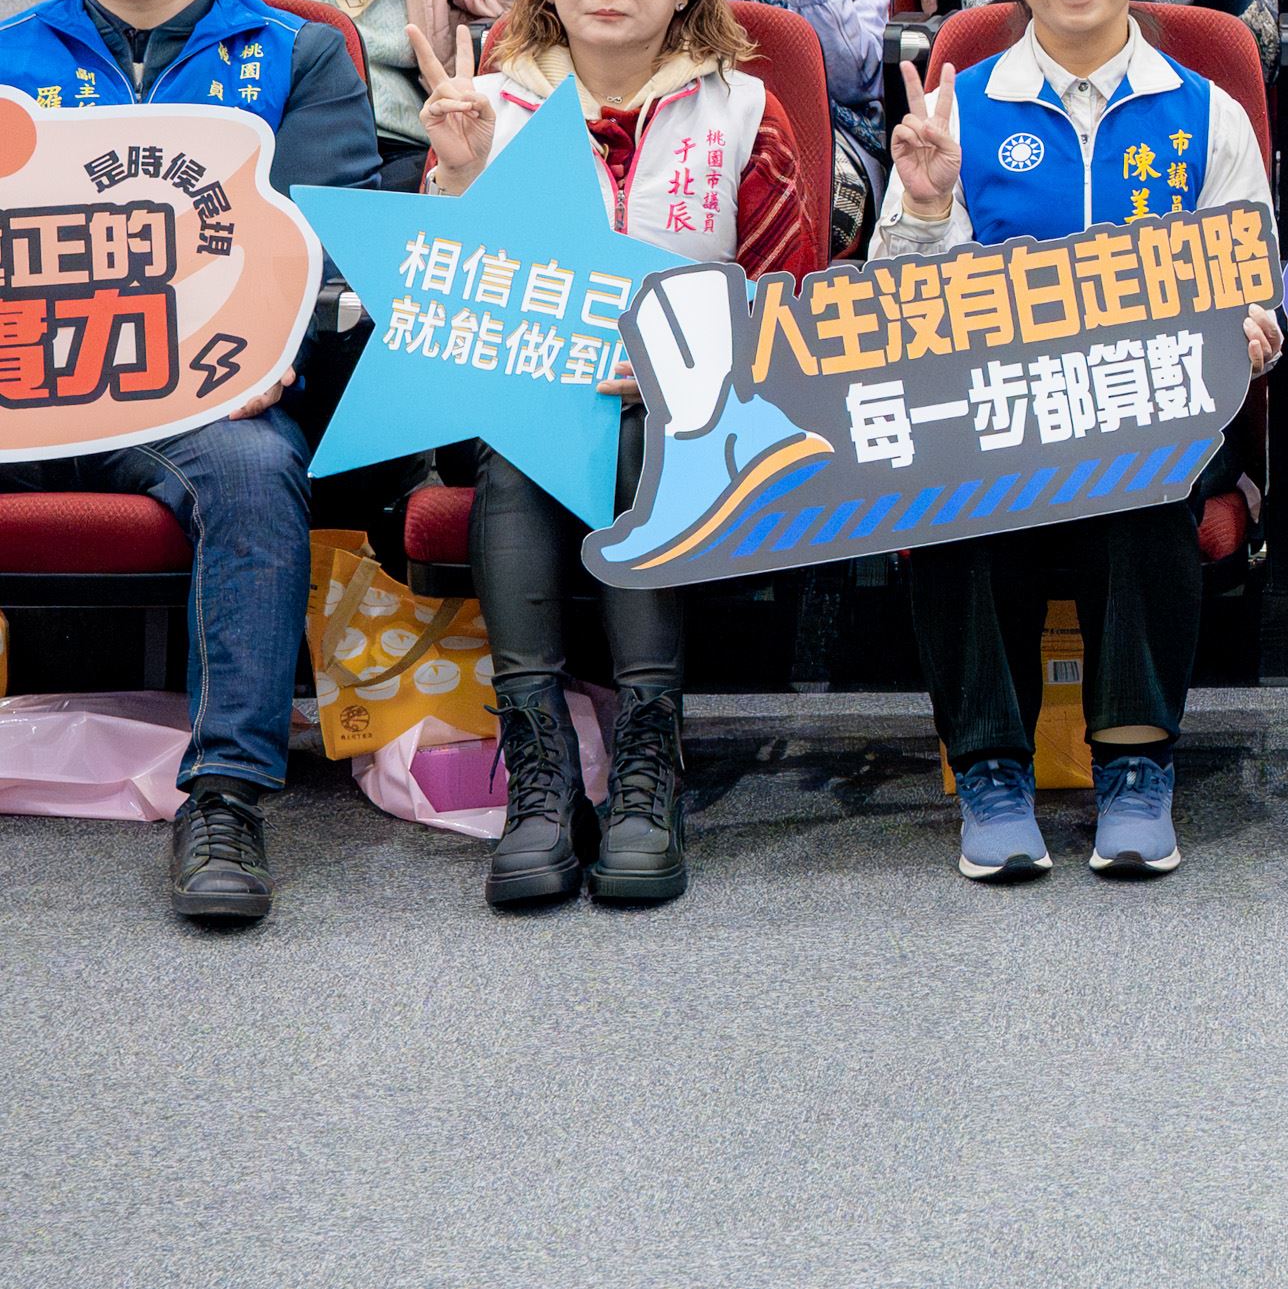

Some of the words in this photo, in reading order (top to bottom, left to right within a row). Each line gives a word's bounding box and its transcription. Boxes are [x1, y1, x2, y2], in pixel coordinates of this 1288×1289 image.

[238, 43, 264, 104] 桃園市
[83, 146, 235, 257] 是時候展現
[666, 137, 697, 233] 于北辰
[702, 129, 726, 233] 桃園市議員
[0, 209, 169, 289] 正的
[400, 231, 633, 332] 相信自己
[752, 209, 1274, 384] 人生沒有白走的路
[846, 330, 1217, 470] 每一步都算數
